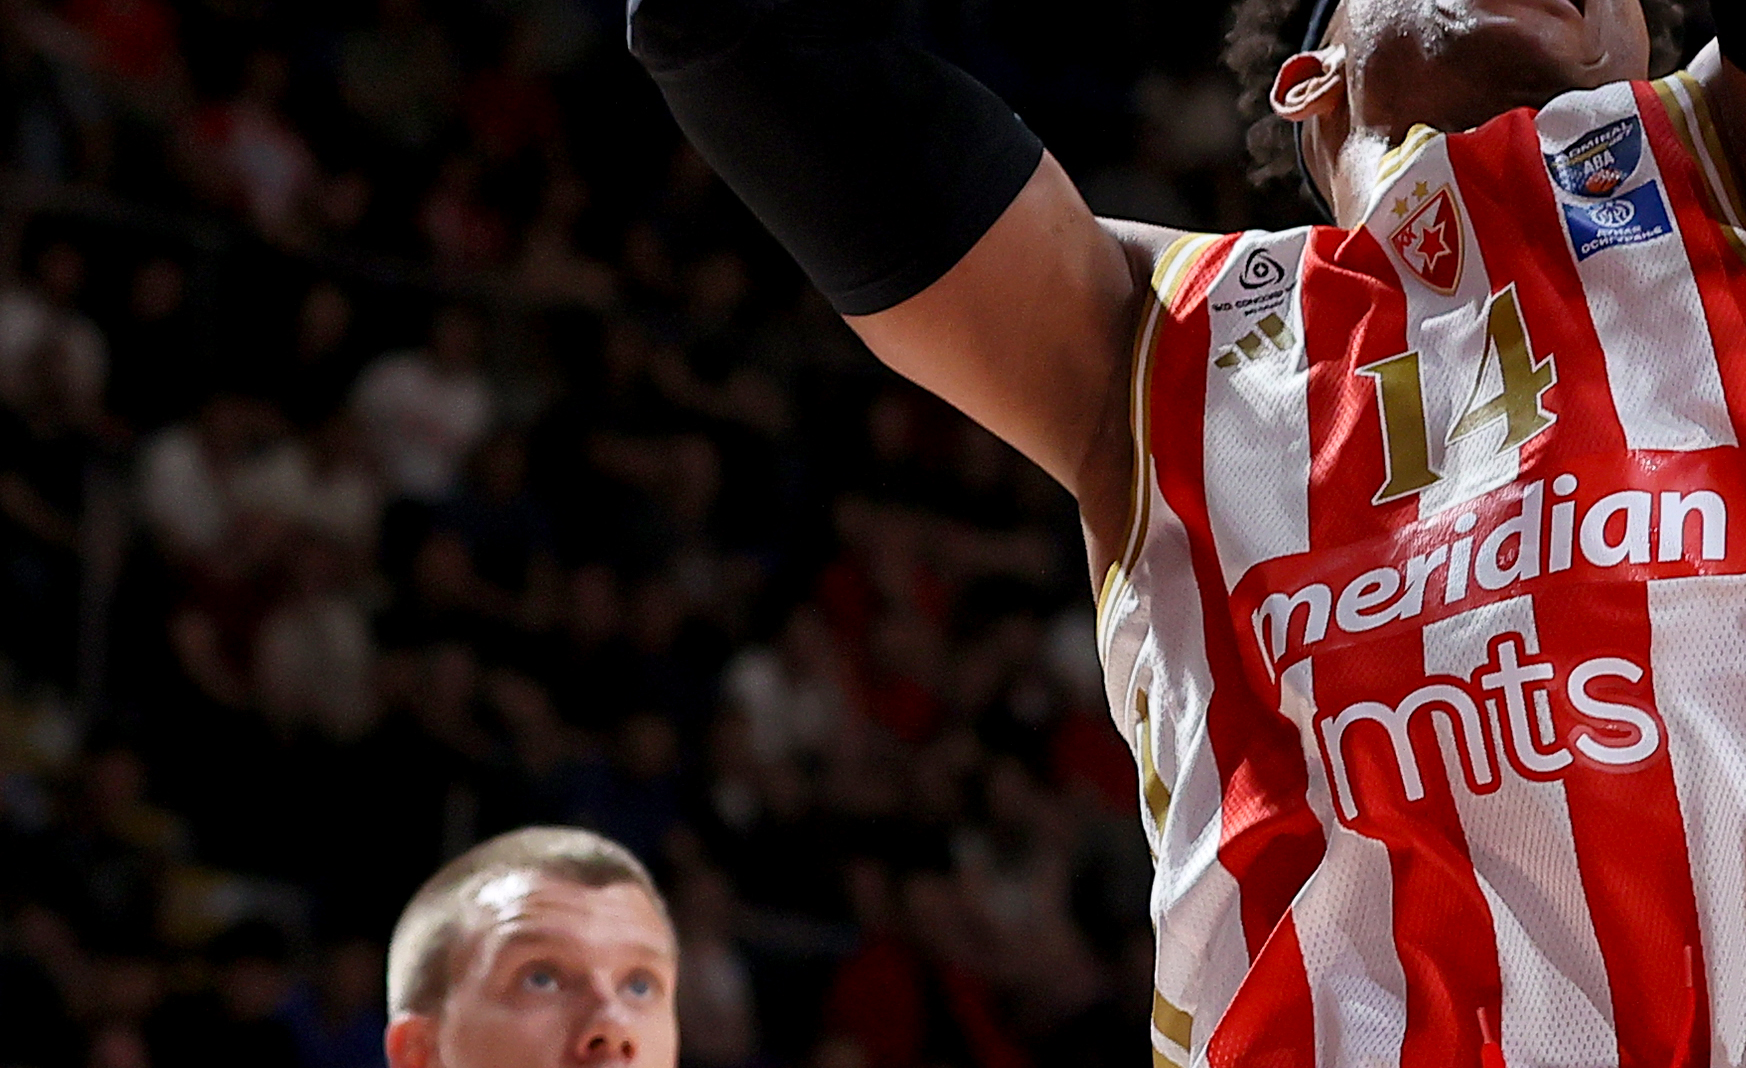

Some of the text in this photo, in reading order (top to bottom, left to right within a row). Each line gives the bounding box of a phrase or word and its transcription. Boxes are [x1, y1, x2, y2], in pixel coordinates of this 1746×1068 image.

[1583, 150, 1615, 175] ABA
[1355, 282, 1558, 506] 14
[1252, 473, 1727, 684] meridian
[1321, 638, 1660, 822] mts
